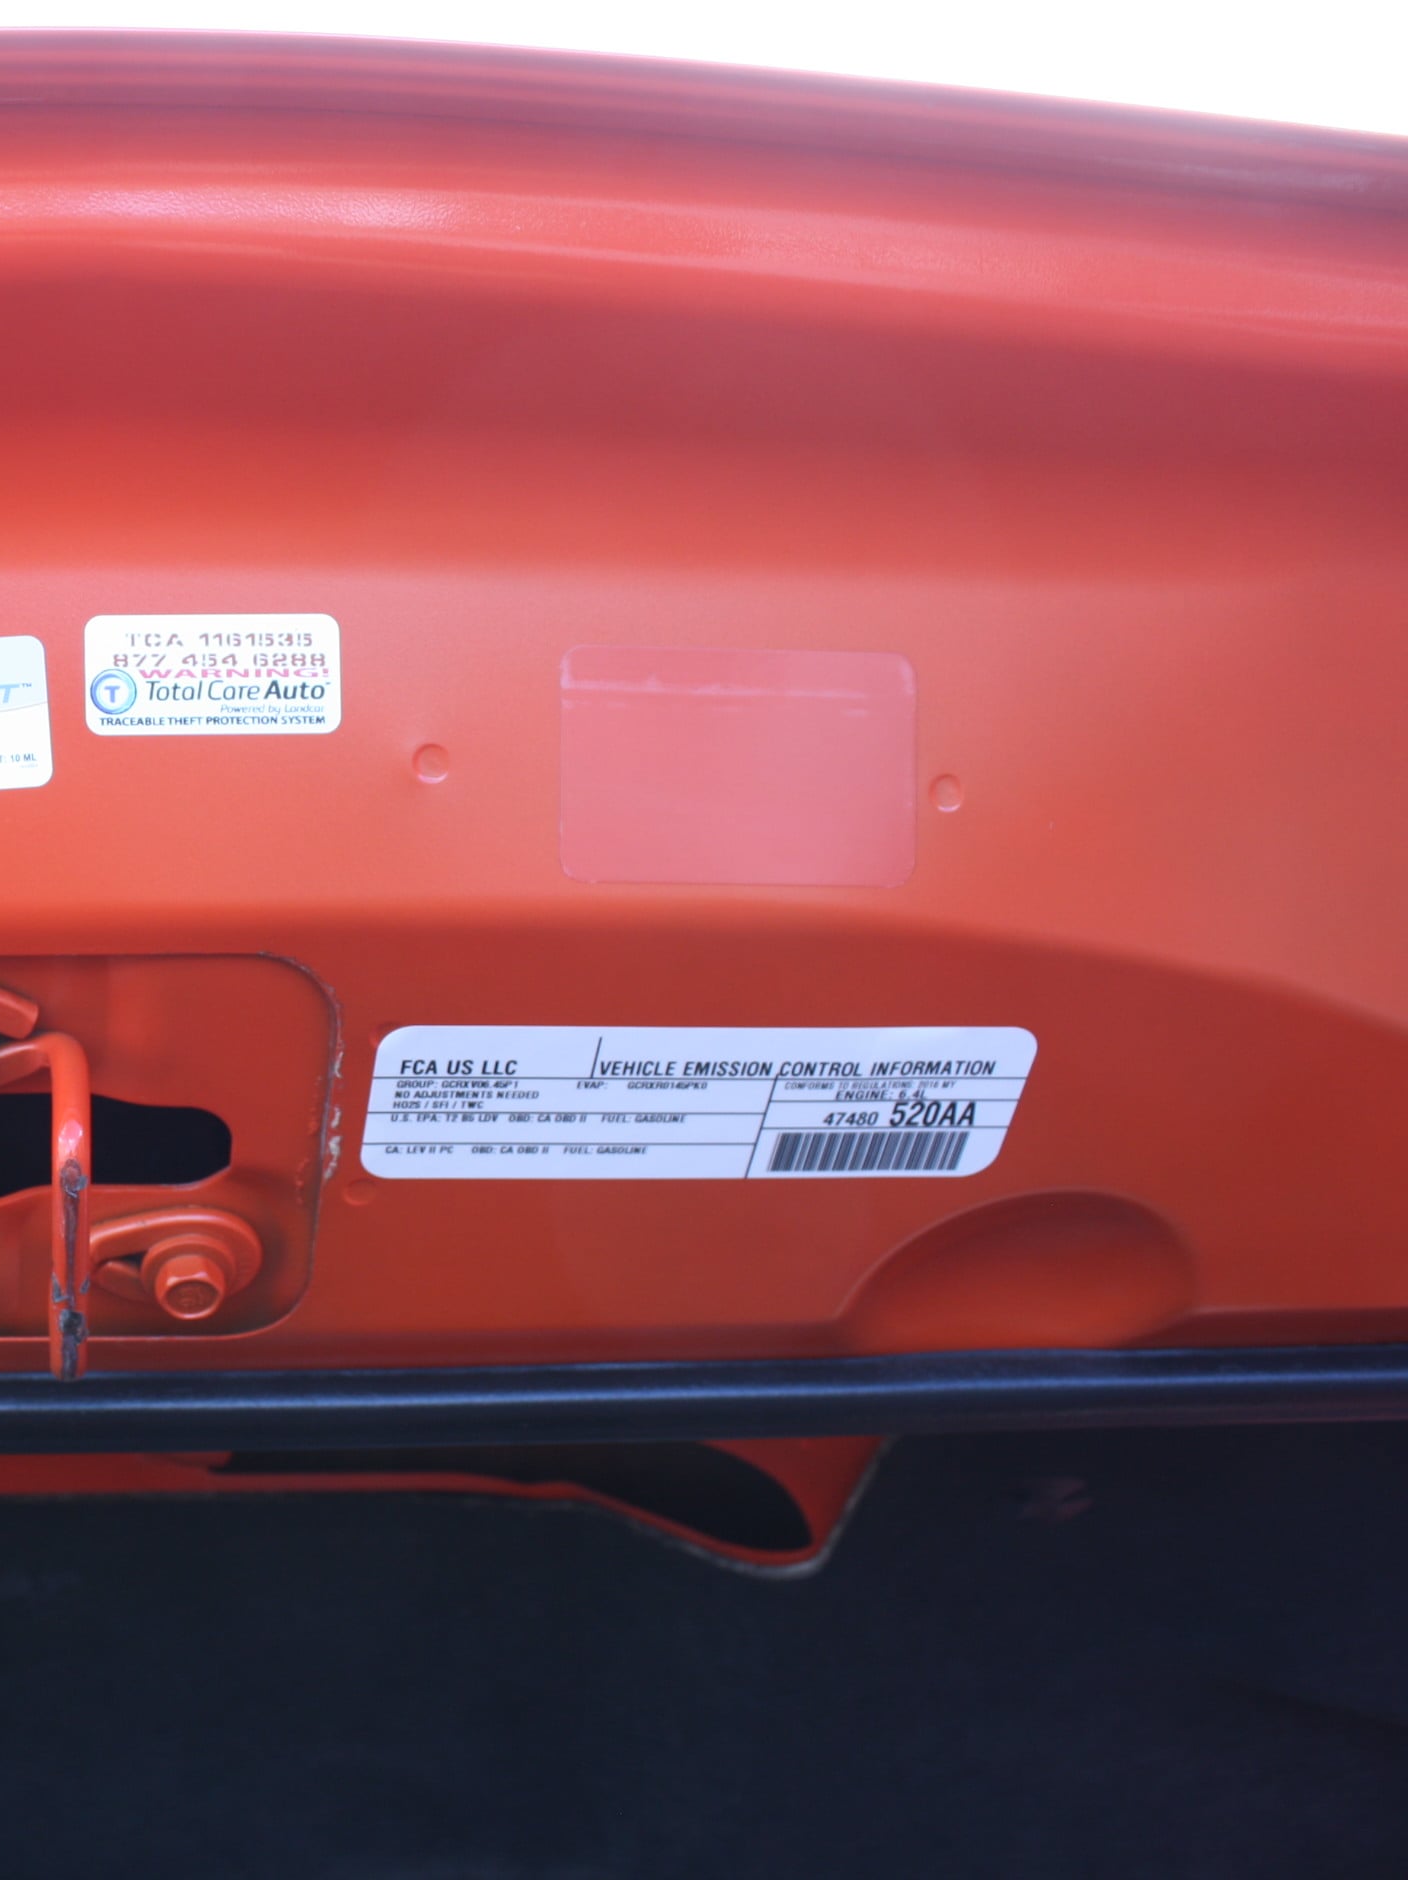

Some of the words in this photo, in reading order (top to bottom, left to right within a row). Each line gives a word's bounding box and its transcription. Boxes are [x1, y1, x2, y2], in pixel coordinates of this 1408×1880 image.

[126, 633, 184, 647] TCA
[199, 633, 313, 647] 1161535
[113, 654, 166, 667] 877
[182, 654, 238, 667] 454
[253, 653, 326, 667] 6288
[139, 668, 329, 678] WARNING!
[145, 680, 203, 701] Total
[207, 680, 261, 701] Care
[220, 704, 265, 713] Powered
[268, 704, 281, 714] by
[284, 704, 325, 713] Landcar
[100, 716, 166, 726] TRACEABLE
[167, 716, 203, 725] THEFT
[206, 716, 278, 725] PROTECTION
[281, 715, 326, 725] SYSTEM
[10, 753, 21, 763] 10
[23, 752, 37, 762] ML
[400, 1060, 438, 1075] FCA
[446, 1060, 473, 1075] US
[481, 1060, 518, 1075] LLC
[599, 1061, 677, 1076] VEHICLE
[682, 1062, 773, 1077] EMISSION
[778, 1062, 862, 1077] CONTROL
[870, 1061, 996, 1076] INFORMATION
[396, 1080, 439, 1089] GROUP:
[576, 1081, 608, 1090] EVAP:
[784, 1081, 835, 1090] CONFORMS
[838, 1081, 851, 1090] TO
[394, 1090, 411, 1099] NO
[413, 1090, 493, 1100] ADJUSTMENTS
[496, 1090, 539, 1099] NEEDED
[835, 1090, 895, 1100] ENGINE:
[898, 1089, 928, 1099] 6.4L
[431, 1100, 449, 1109] SFI
[460, 1100, 484, 1110] TWC
[390, 1113, 413, 1123] U.S.
[416, 1113, 442, 1123] EPA:
[508, 1113, 535, 1123] OBD:
[537, 1113, 552, 1123] CA
[554, 1113, 578, 1123] OBD
[600, 1113, 632, 1123] FUEL:
[633, 1114, 687, 1124] GASOLINE
[822, 1111, 879, 1126] 47480
[889, 1101, 977, 1127] 520AA
[385, 1145, 404, 1154] CA:
[406, 1145, 427, 1154] LEV
[439, 1145, 454, 1154] PC
[471, 1145, 498, 1154] OBD:
[500, 1145, 514, 1154] CA
[516, 1145, 539, 1154] OBD
[562, 1145, 594, 1154] FUEL:
[595, 1145, 648, 1155] GASOLINE
